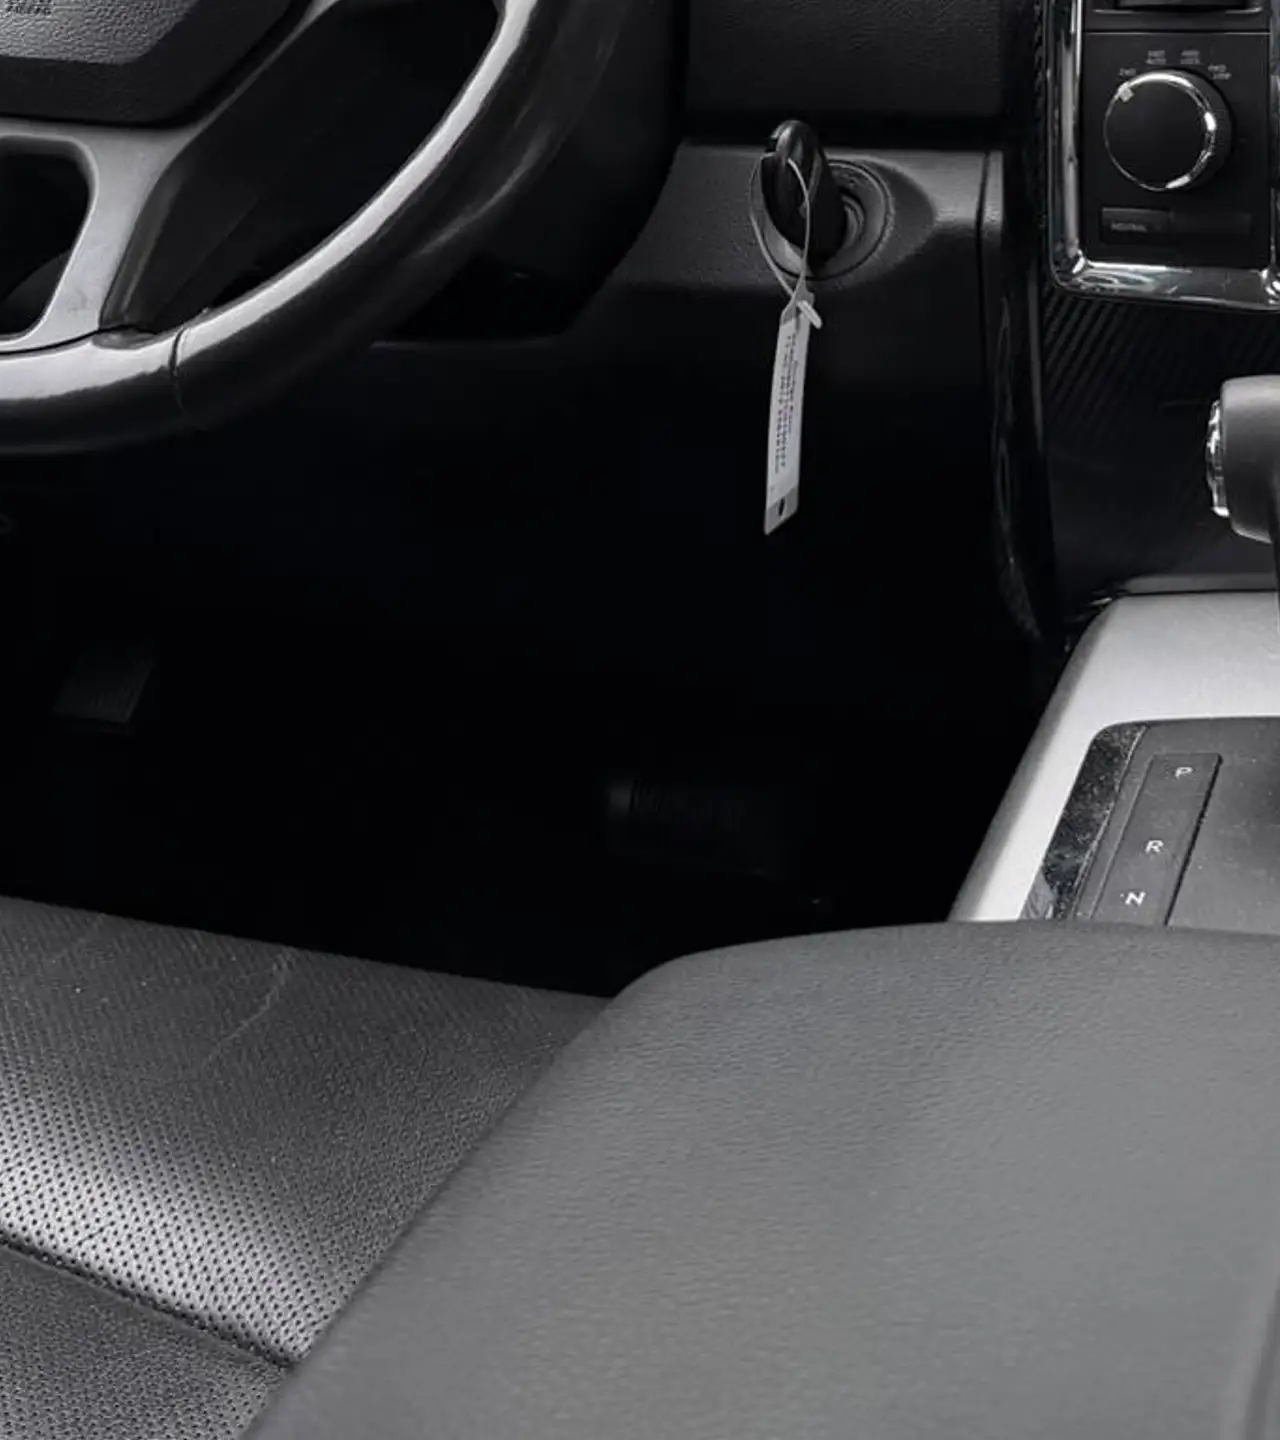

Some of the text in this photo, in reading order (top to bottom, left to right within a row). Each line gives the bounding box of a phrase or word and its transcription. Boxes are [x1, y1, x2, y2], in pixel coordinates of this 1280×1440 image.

[1175, 766, 1193, 781] P
[1144, 839, 1165, 854] R
[1124, 891, 1147, 906] N
